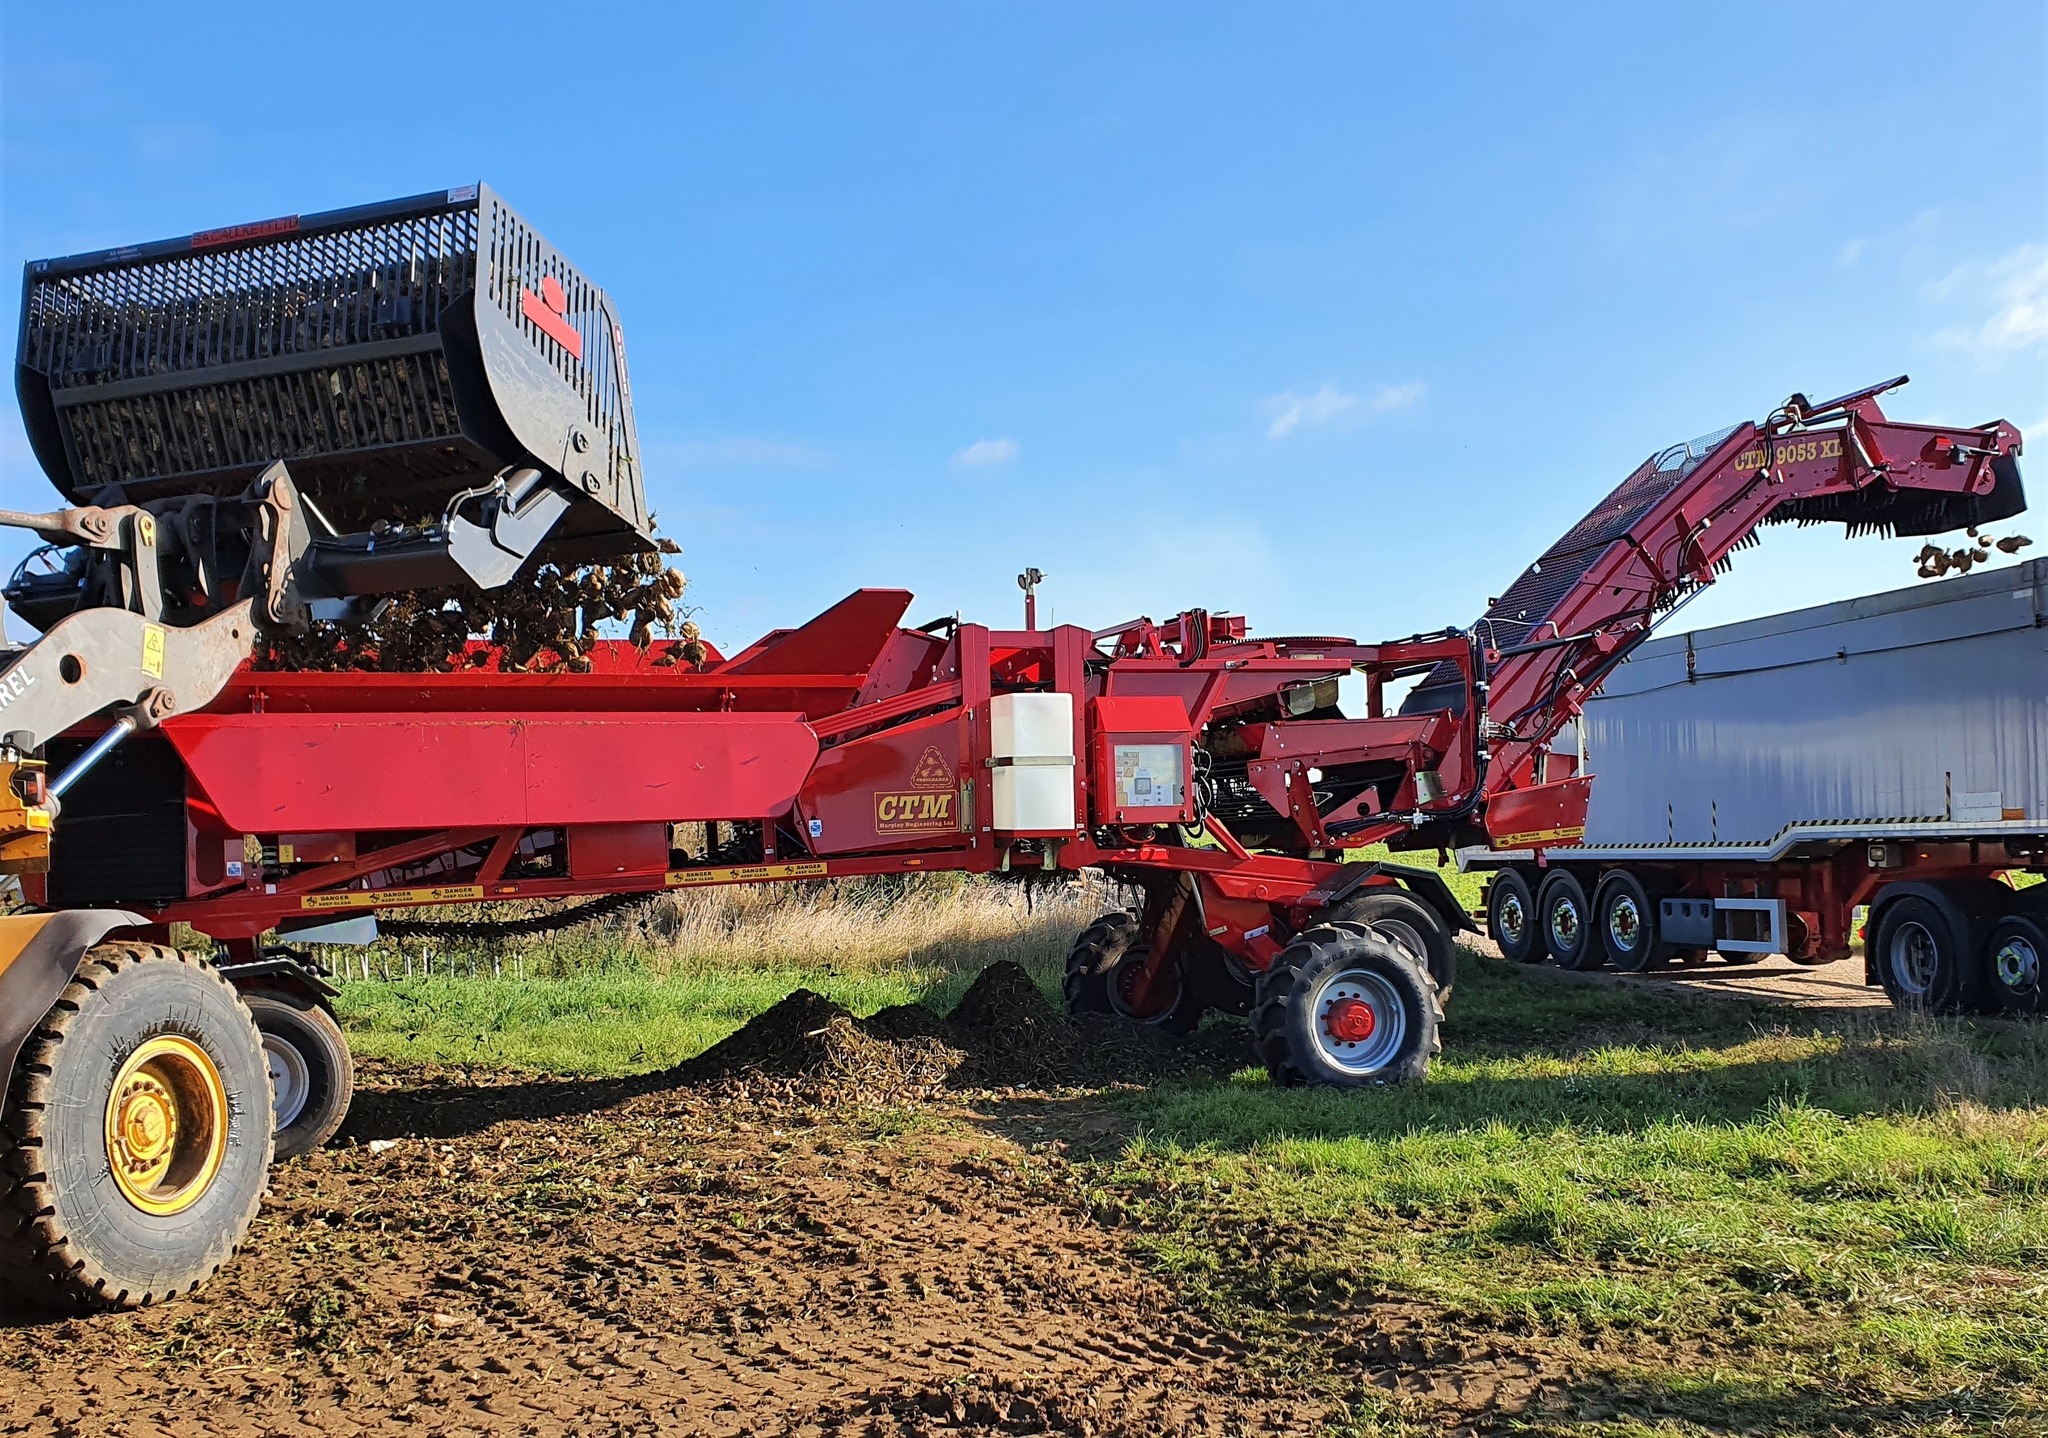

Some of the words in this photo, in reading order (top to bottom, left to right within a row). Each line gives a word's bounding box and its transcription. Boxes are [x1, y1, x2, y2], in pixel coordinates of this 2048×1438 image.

[1776, 442, 1817, 465] 9053
[1820, 438, 1844, 458] XL
[0, 665, 36, 712] REL
[878, 794, 953, 821] CTM
[905, 820, 943, 828] Engineering
